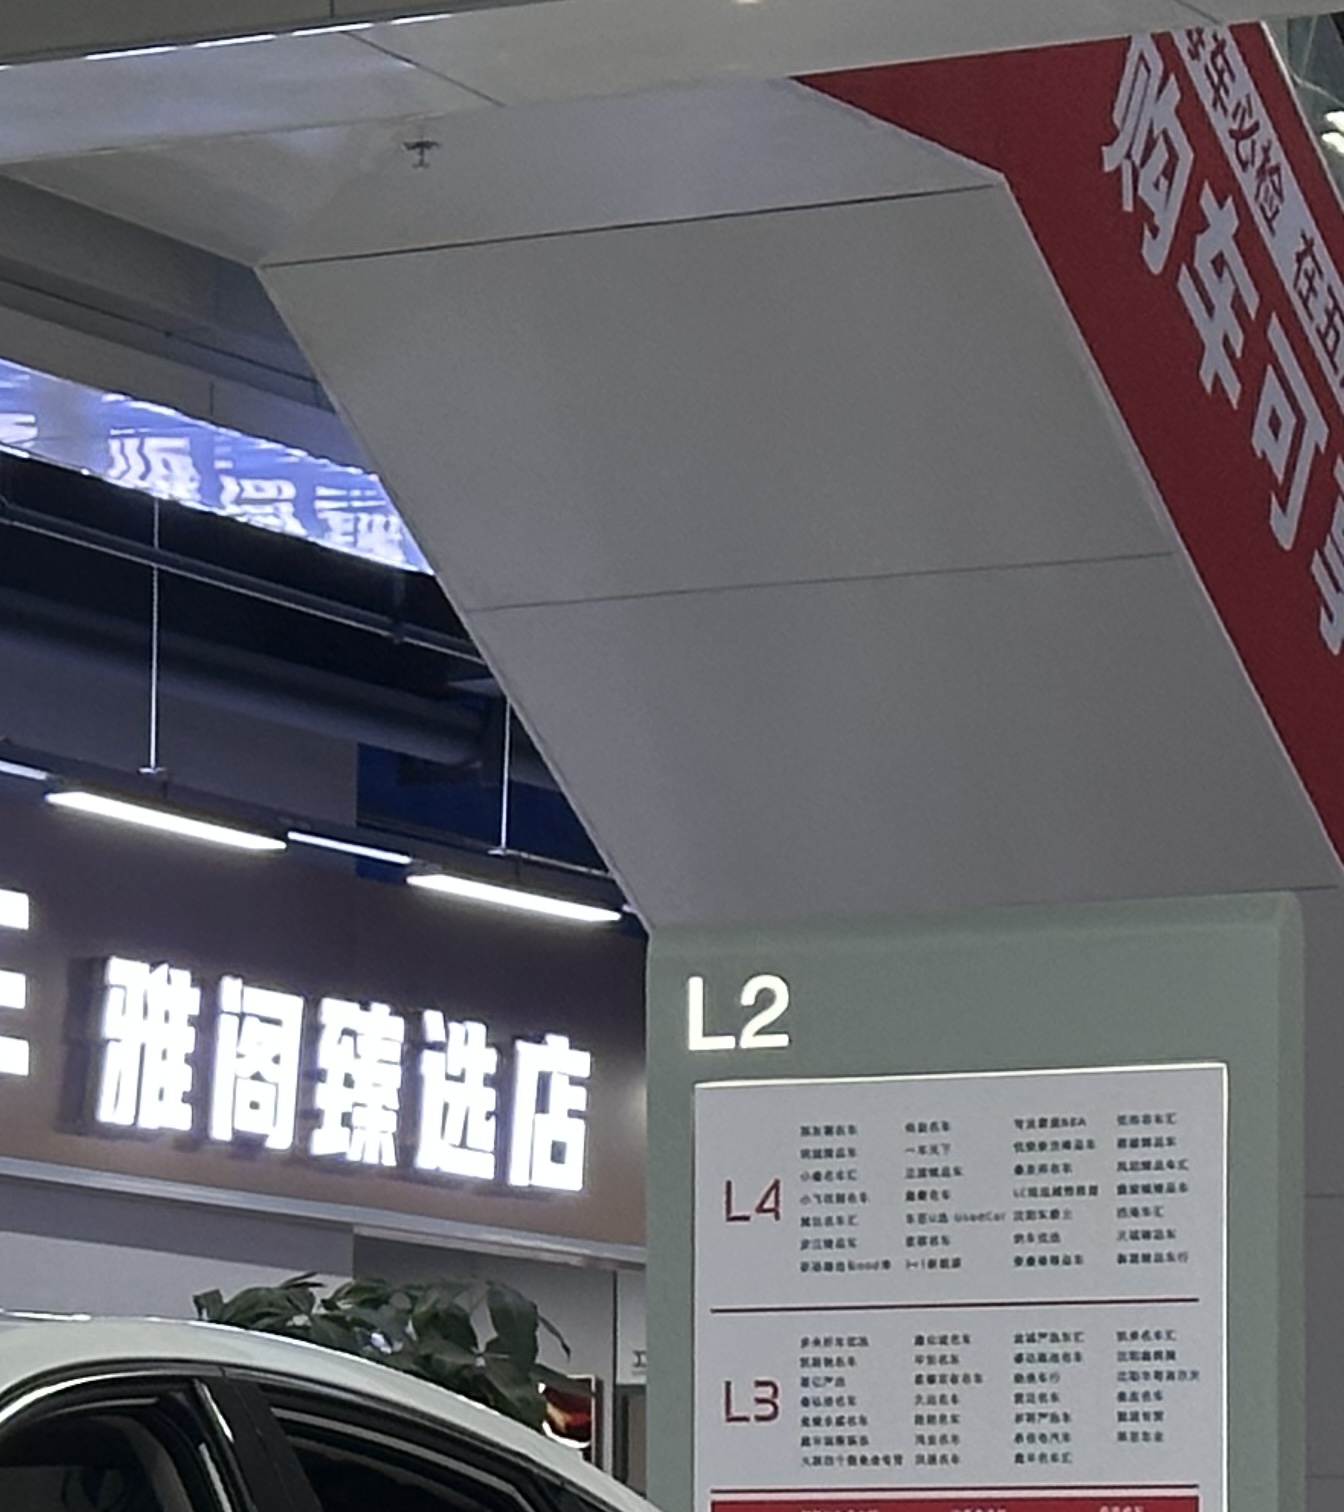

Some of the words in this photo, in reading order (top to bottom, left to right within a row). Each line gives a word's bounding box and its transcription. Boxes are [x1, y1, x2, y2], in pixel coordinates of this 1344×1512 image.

[687, 974, 791, 1052] L2
[97, 955, 593, 1192] 雅阁臻选店
[723, 1178, 782, 1222] L4
[723, 1379, 781, 1423] L3
